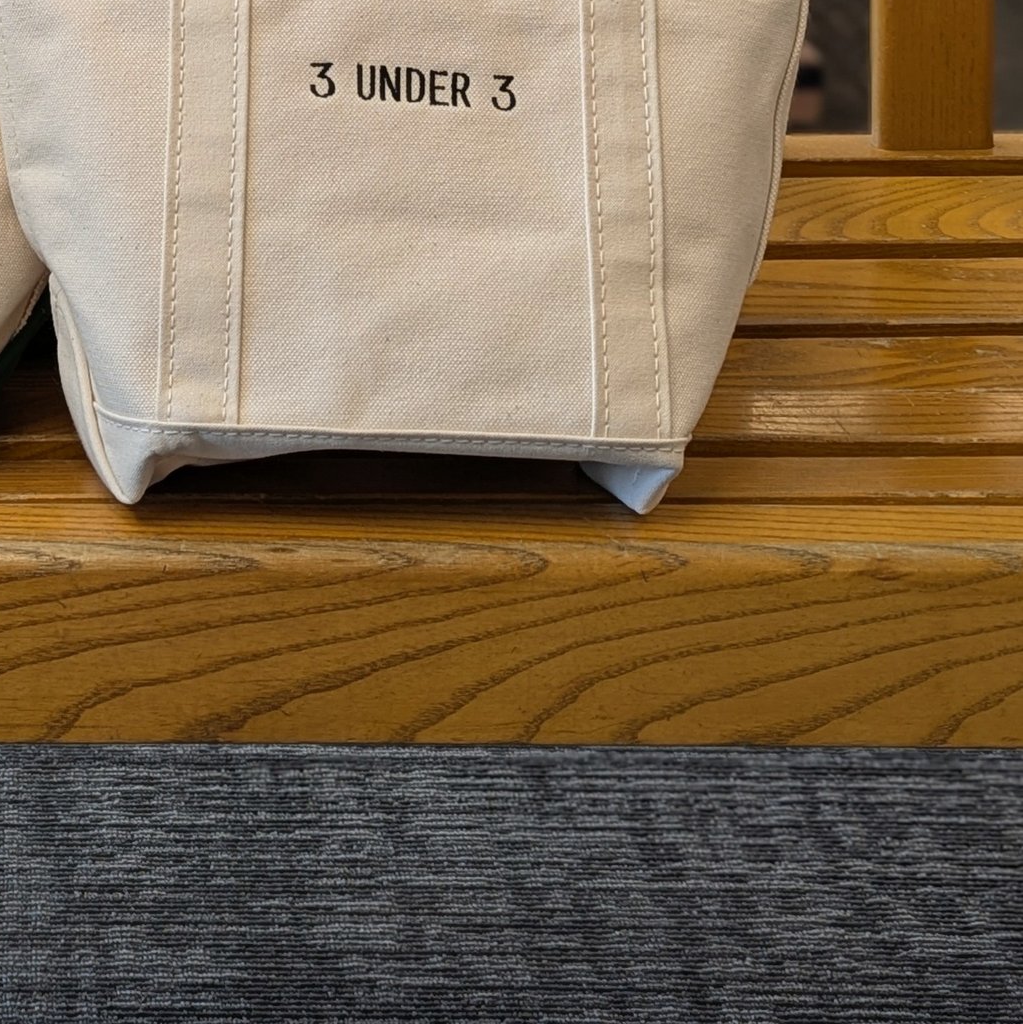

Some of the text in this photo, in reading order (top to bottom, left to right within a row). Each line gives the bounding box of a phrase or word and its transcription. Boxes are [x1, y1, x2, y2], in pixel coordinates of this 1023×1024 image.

[309, 62, 517, 111] 3 UNDER 3
